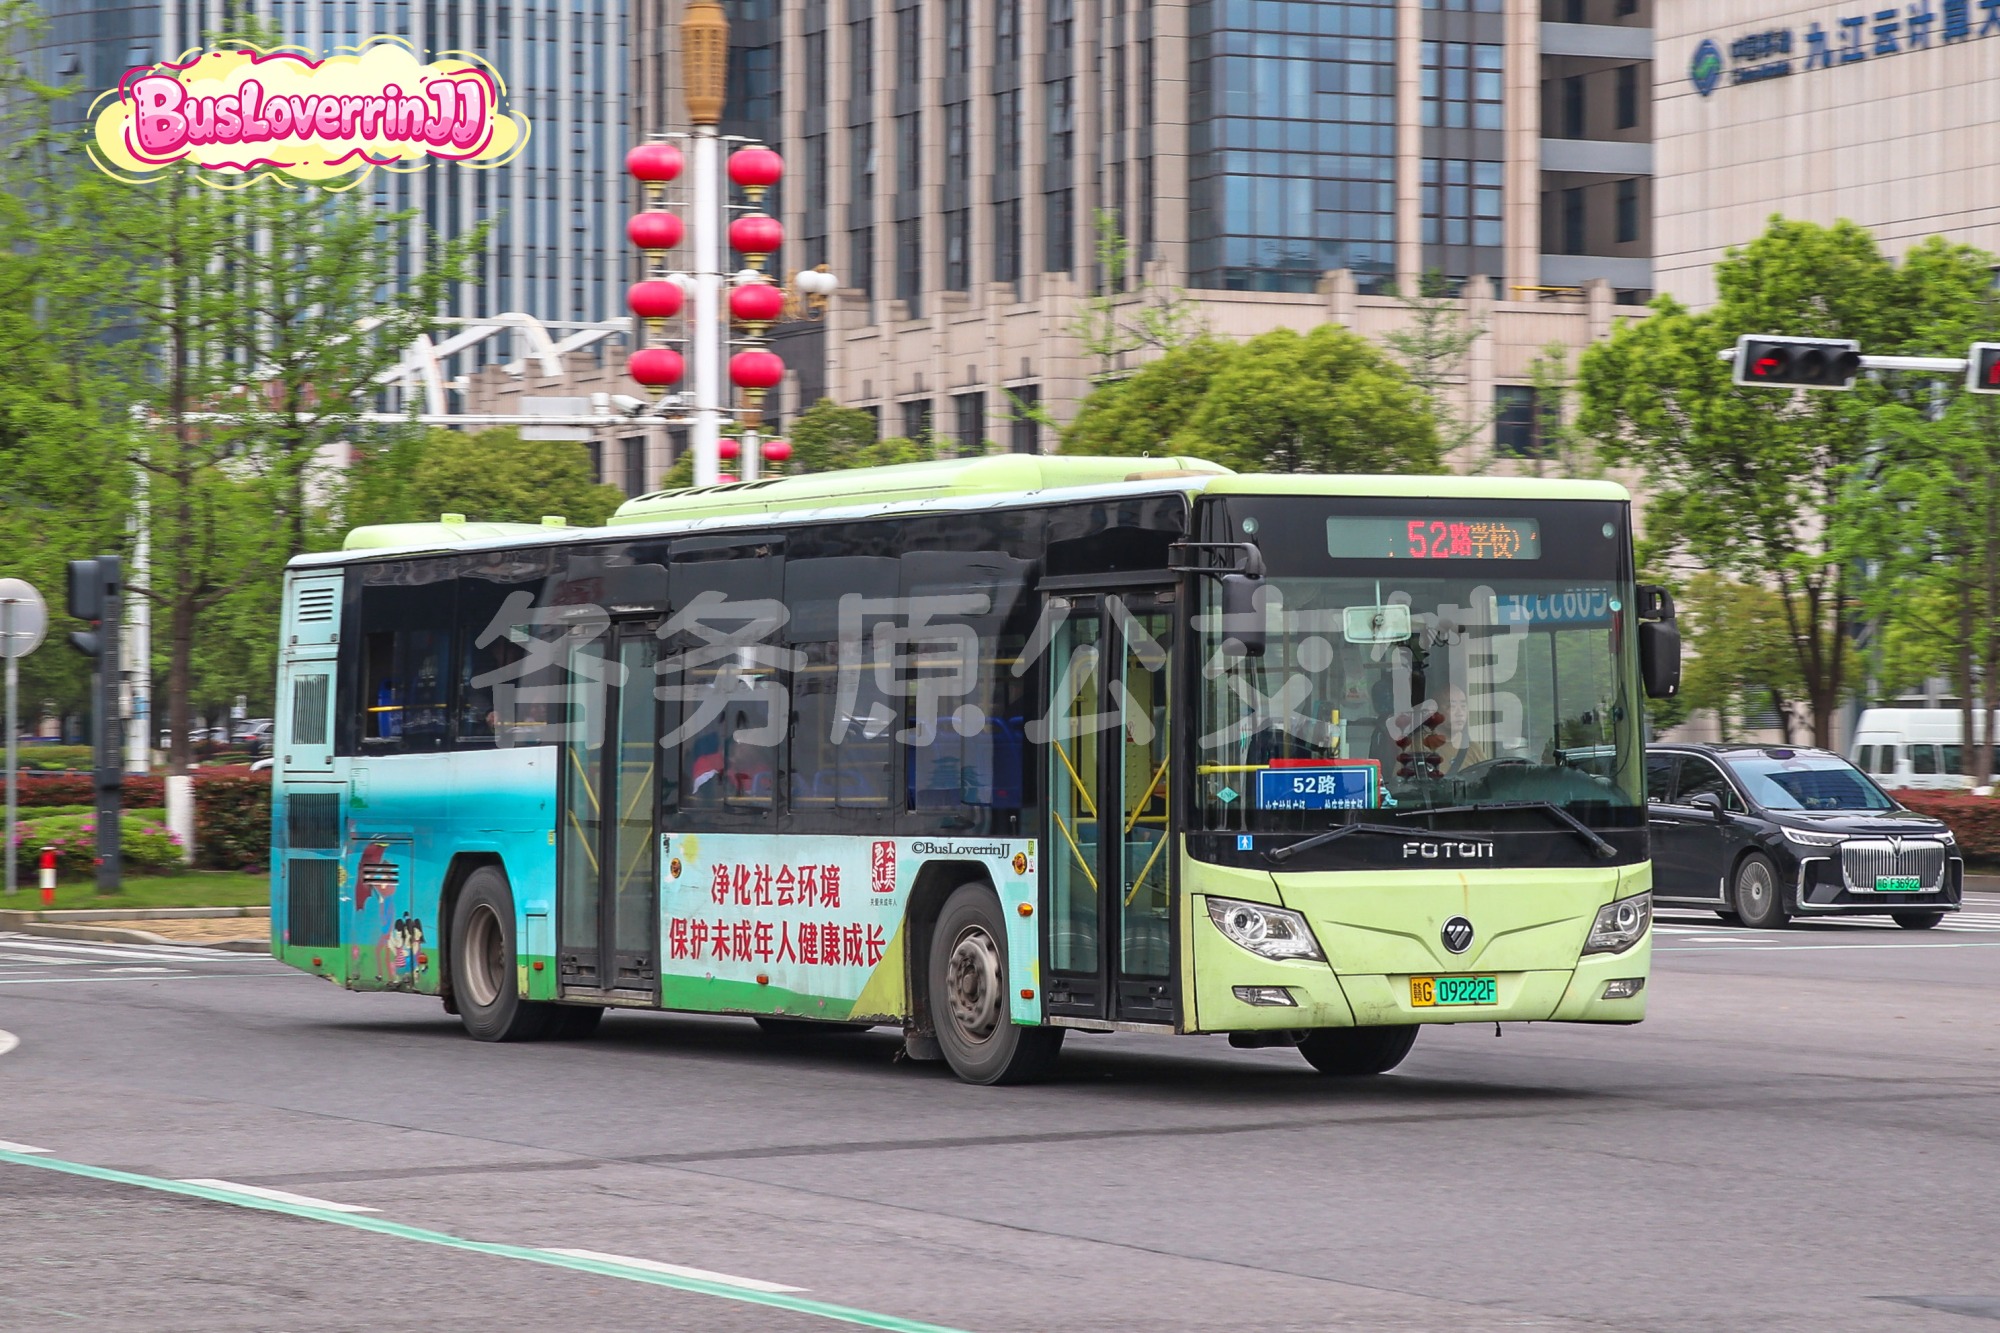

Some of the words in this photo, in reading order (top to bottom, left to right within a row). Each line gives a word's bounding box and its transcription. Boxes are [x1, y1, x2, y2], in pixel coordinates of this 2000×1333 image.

[1293, 775, 1336, 794] 52路
[1402, 842, 1494, 858] FOTON
[711, 864, 840, 908] 净化社会环境
[669, 918, 886, 967] 保护未成年人健康成长
